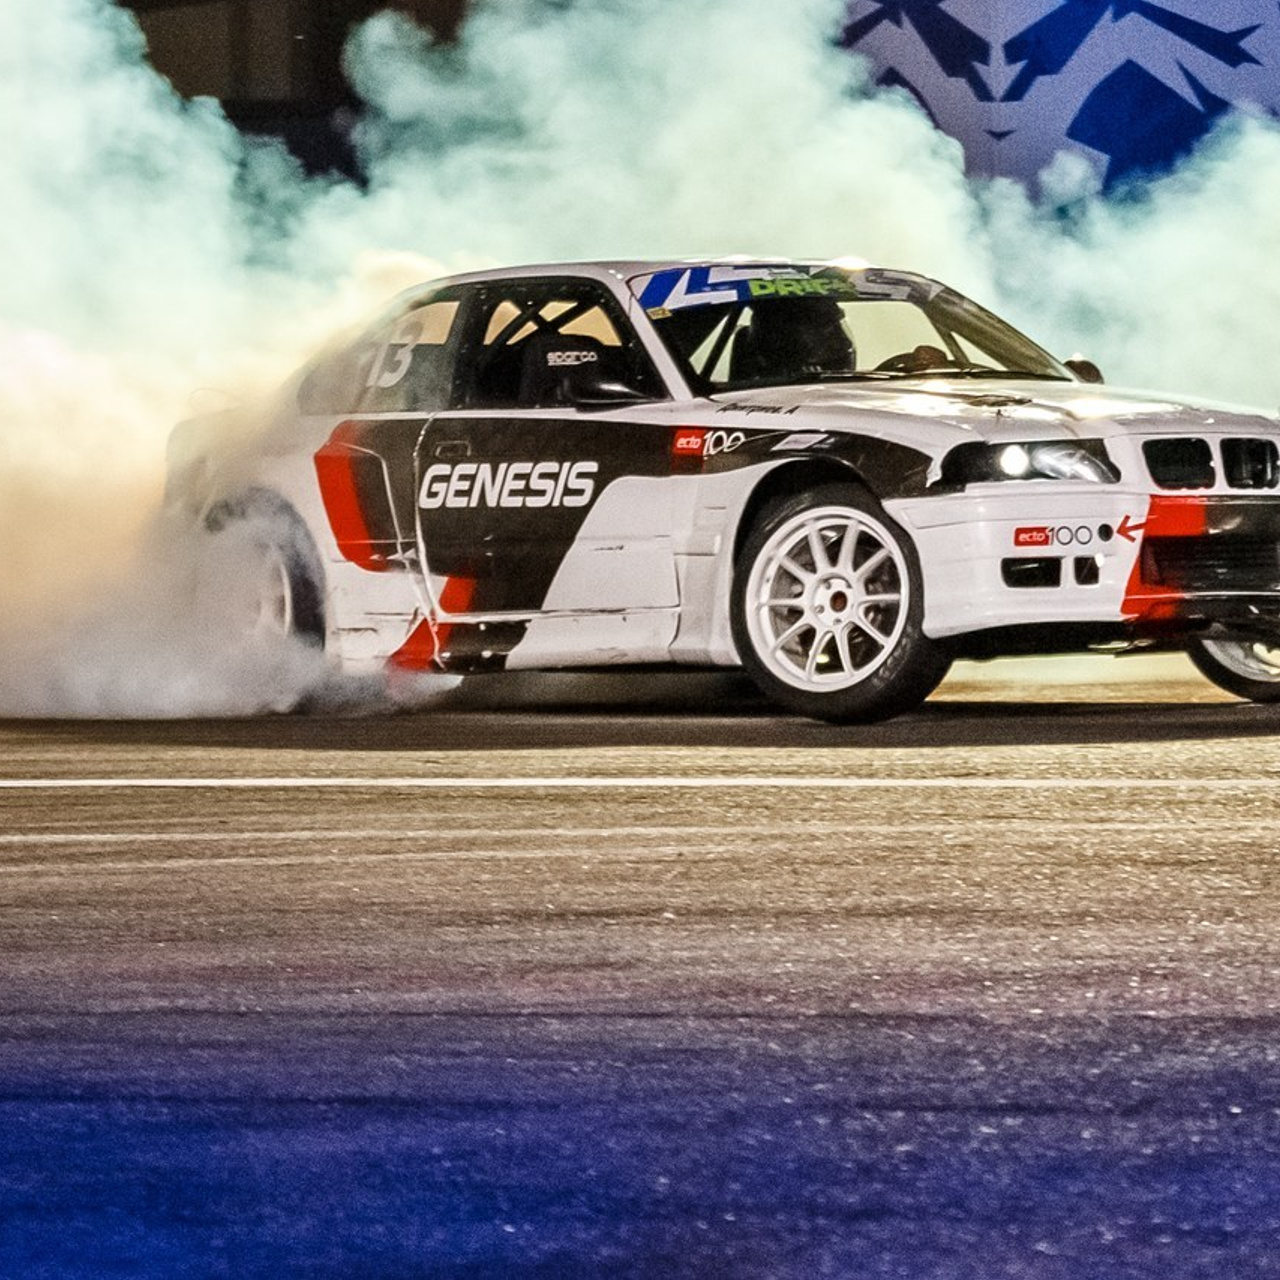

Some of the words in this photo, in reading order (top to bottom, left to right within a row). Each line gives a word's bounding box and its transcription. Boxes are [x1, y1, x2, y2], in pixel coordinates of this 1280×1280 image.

[546, 352, 598, 366] sparco
[703, 430, 746, 457] 100
[418, 461, 599, 509] GENESIS
[1046, 525, 1093, 545] 100
